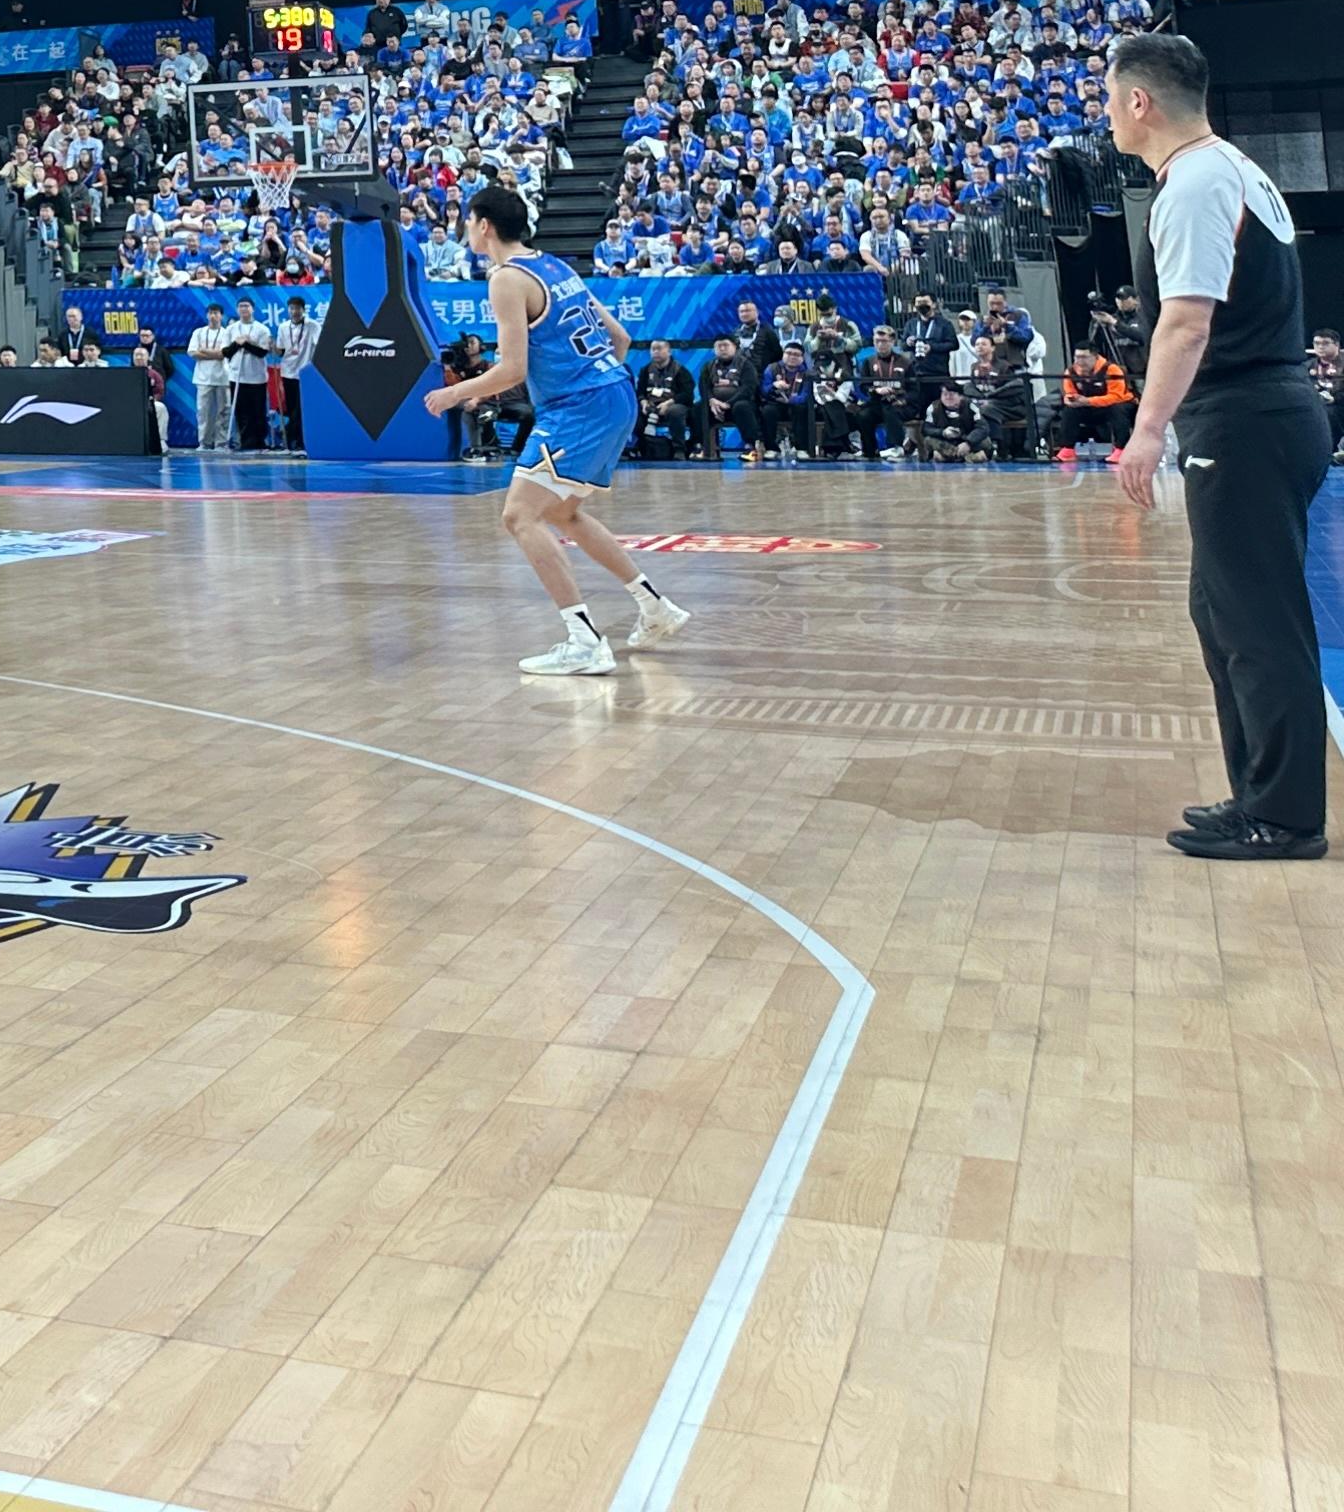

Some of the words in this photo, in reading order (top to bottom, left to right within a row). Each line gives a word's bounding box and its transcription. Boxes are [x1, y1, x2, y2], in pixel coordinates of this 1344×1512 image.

[277, 28, 302, 51] 19
[12, 41, 66, 63] 在一起
[344, 347, 396, 357] LI-NING
